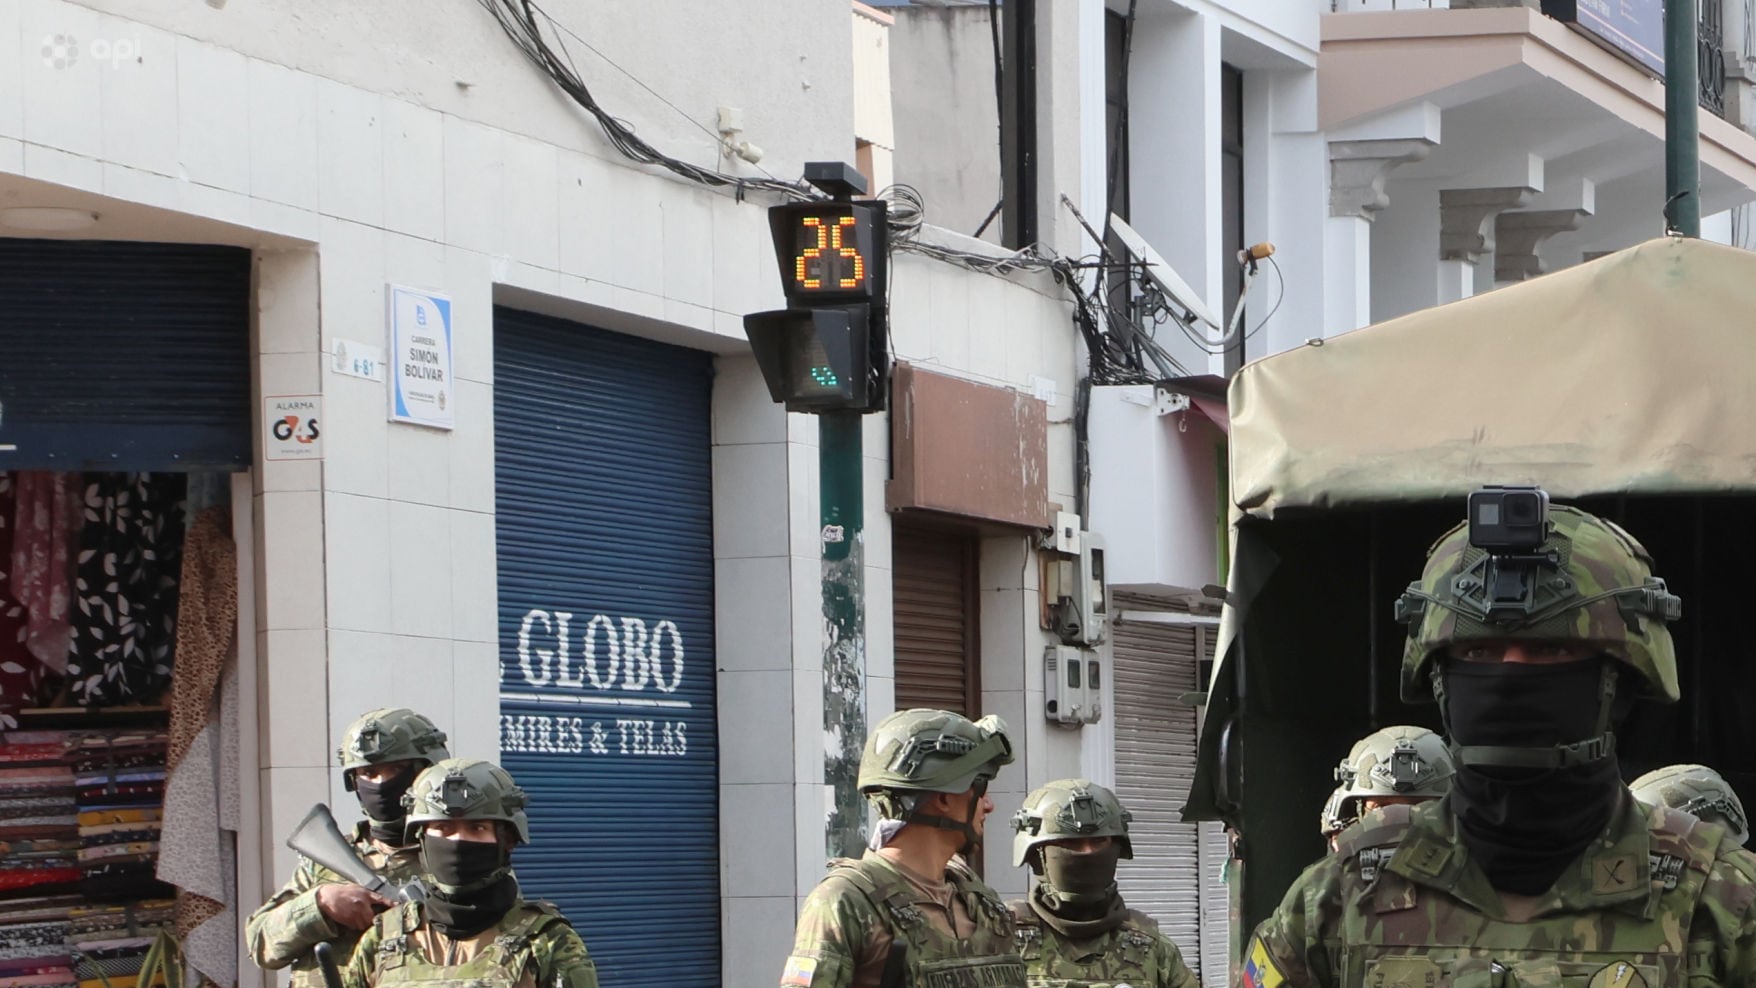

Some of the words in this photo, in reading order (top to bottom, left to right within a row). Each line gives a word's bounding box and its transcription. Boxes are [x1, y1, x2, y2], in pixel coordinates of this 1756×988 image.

[796, 217, 863, 288] 25
[409, 347, 439, 365] SIMÓN
[404, 363, 444, 382] BOLÍVAR
[275, 401, 315, 410] ALARMA
[273, 415, 320, 444] G4S
[517, 608, 685, 693] GLOBO
[588, 720, 609, 754] &
[616, 719, 688, 756] TELAS
